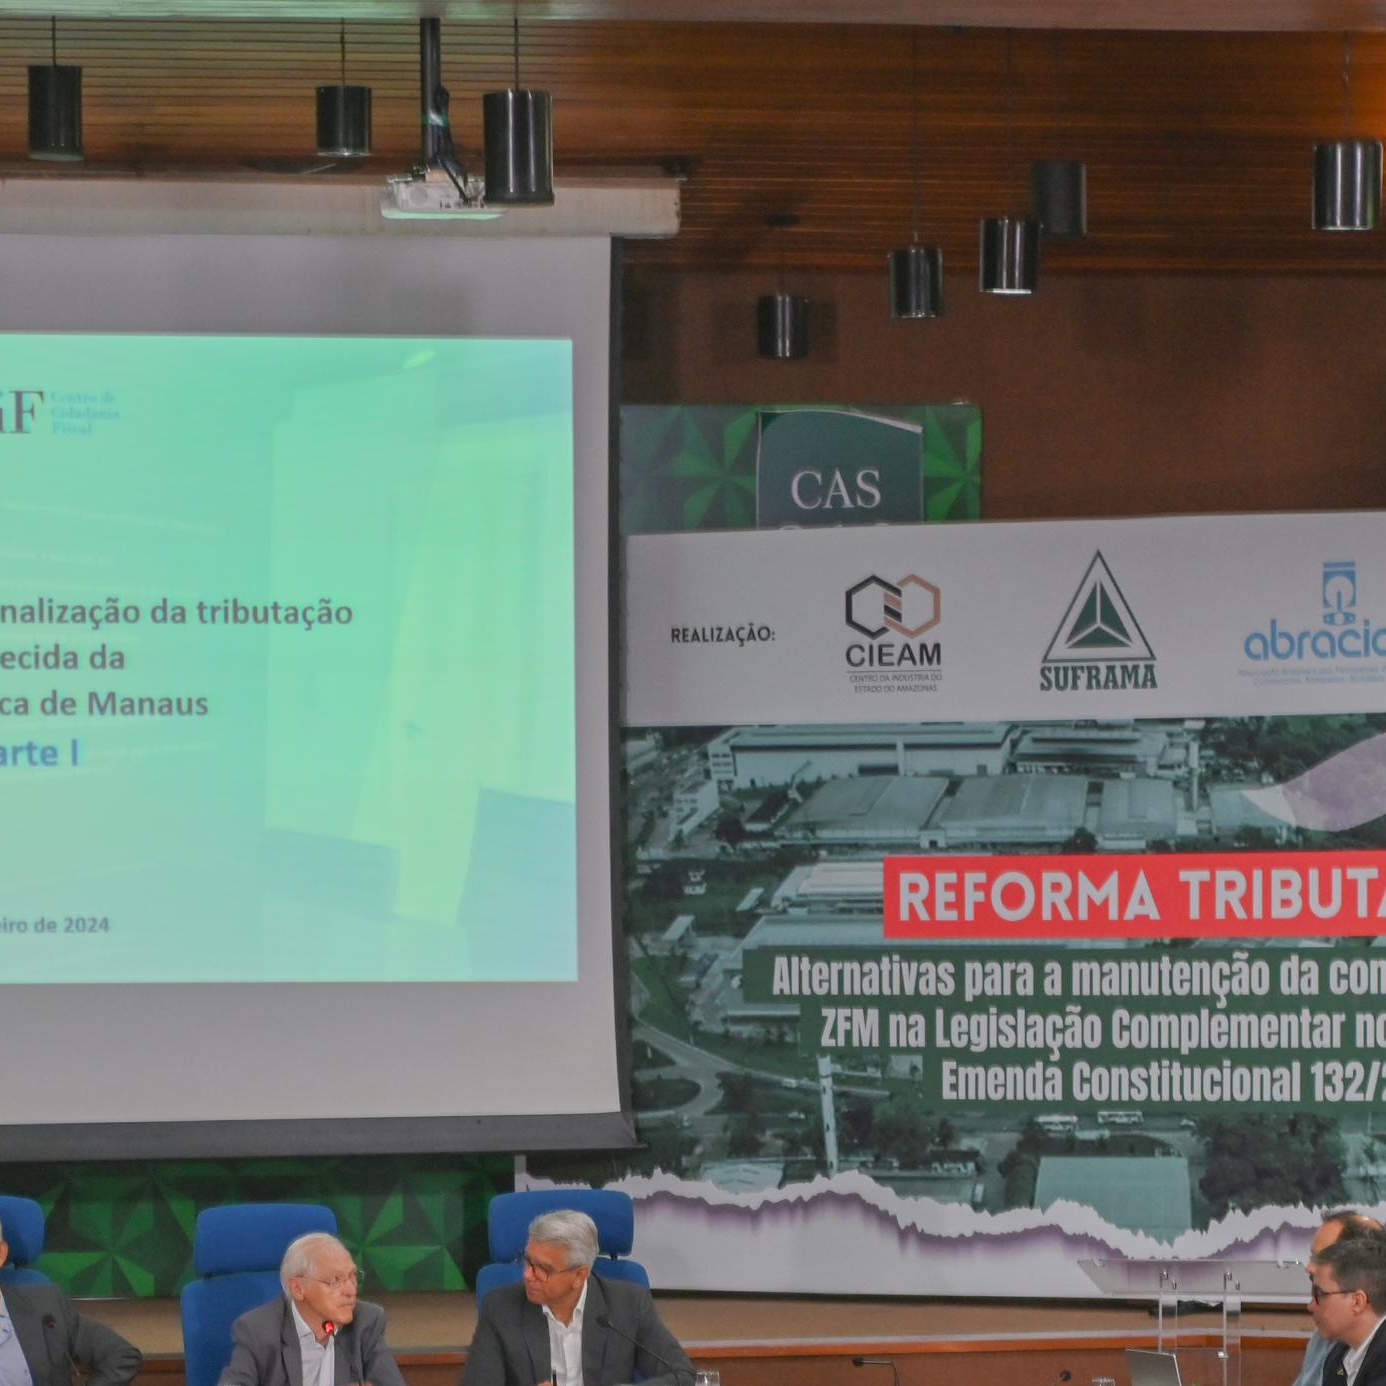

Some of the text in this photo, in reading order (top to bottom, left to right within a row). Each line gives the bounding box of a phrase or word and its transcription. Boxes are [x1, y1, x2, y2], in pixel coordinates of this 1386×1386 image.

[791, 467, 881, 509] CAS
[150, 597, 187, 625] da
[196, 598, 354, 631] tributação
[671, 624, 776, 647] REALIZAÇÃO:
[89, 643, 126, 671] da
[845, 642, 942, 668] CIEAM
[1039, 664, 1159, 691] SUFRAMA
[40, 689, 77, 717] de
[88, 691, 210, 717] Manaus
[899, 870, 1161, 922] REFORMA
[34, 916, 58, 934] de
[63, 917, 110, 934] 2024
[772, 954, 955, 996] Alternativas
[965, 960, 1034, 1002] para
[1044, 961, 1063, 995] a
[1072, 951, 1270, 1008] manutenção
[1280, 954, 1320, 995] da
[821, 1008, 879, 1048] ZFM
[889, 1012, 926, 1048] na
[935, 1004, 1102, 1061] Legislação
[1112, 1005, 1346, 1054] Complementar
[941, 1058, 1063, 1101] Emenda
[1072, 1058, 1301, 1102] Constitucional
